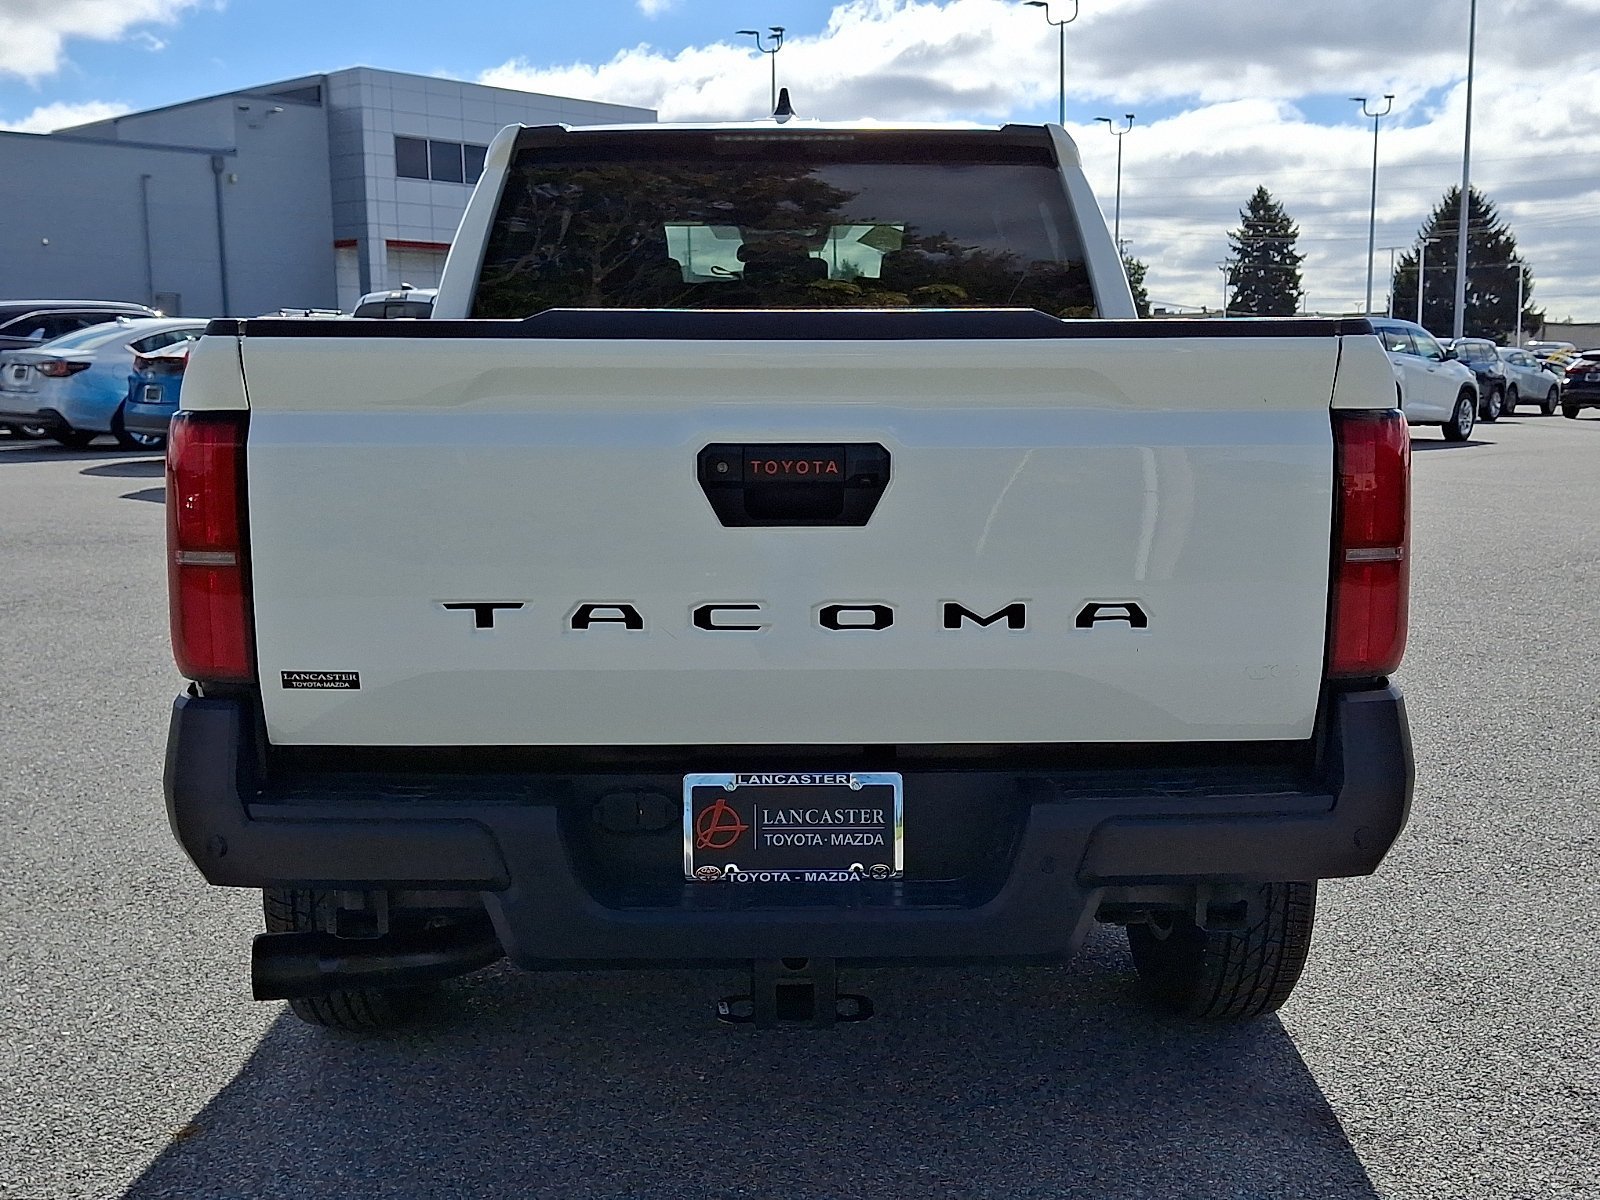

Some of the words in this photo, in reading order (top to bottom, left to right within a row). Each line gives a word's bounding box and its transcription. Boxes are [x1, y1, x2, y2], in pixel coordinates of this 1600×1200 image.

[751, 460, 839, 474] TOYOTA
[441, 600, 1150, 633] TACOMA
[283, 673, 358, 681] LANCASTER
[737, 774, 848, 785] LANCASTER
[762, 809, 886, 825] LANCASTER
[728, 872, 791, 883] TOYOTA
[804, 872, 861, 883] MAZDA
